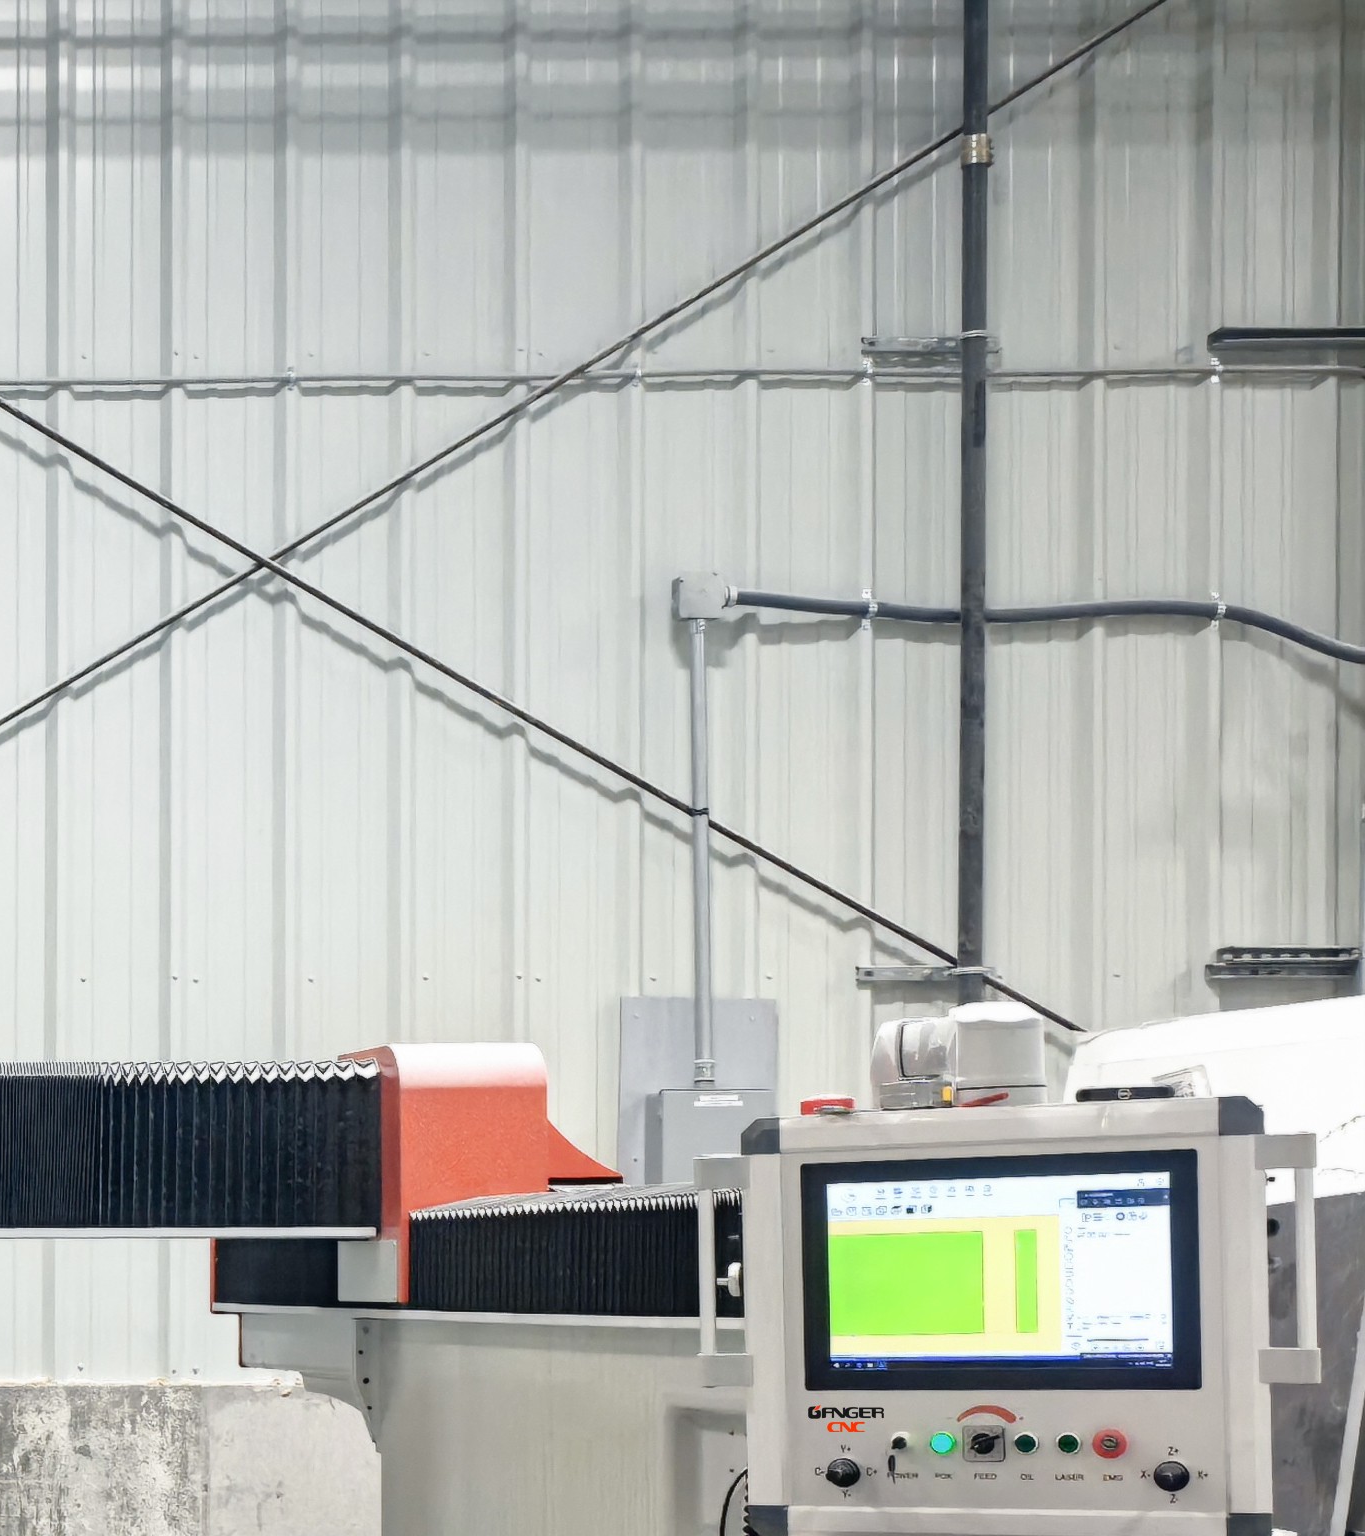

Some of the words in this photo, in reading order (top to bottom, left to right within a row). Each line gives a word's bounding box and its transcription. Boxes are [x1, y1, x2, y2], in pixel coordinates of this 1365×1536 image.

[807, 1404, 885, 1420] GANGER
[826, 1421, 866, 1433] CNC
[1020, 1473, 1035, 1481] OIL
